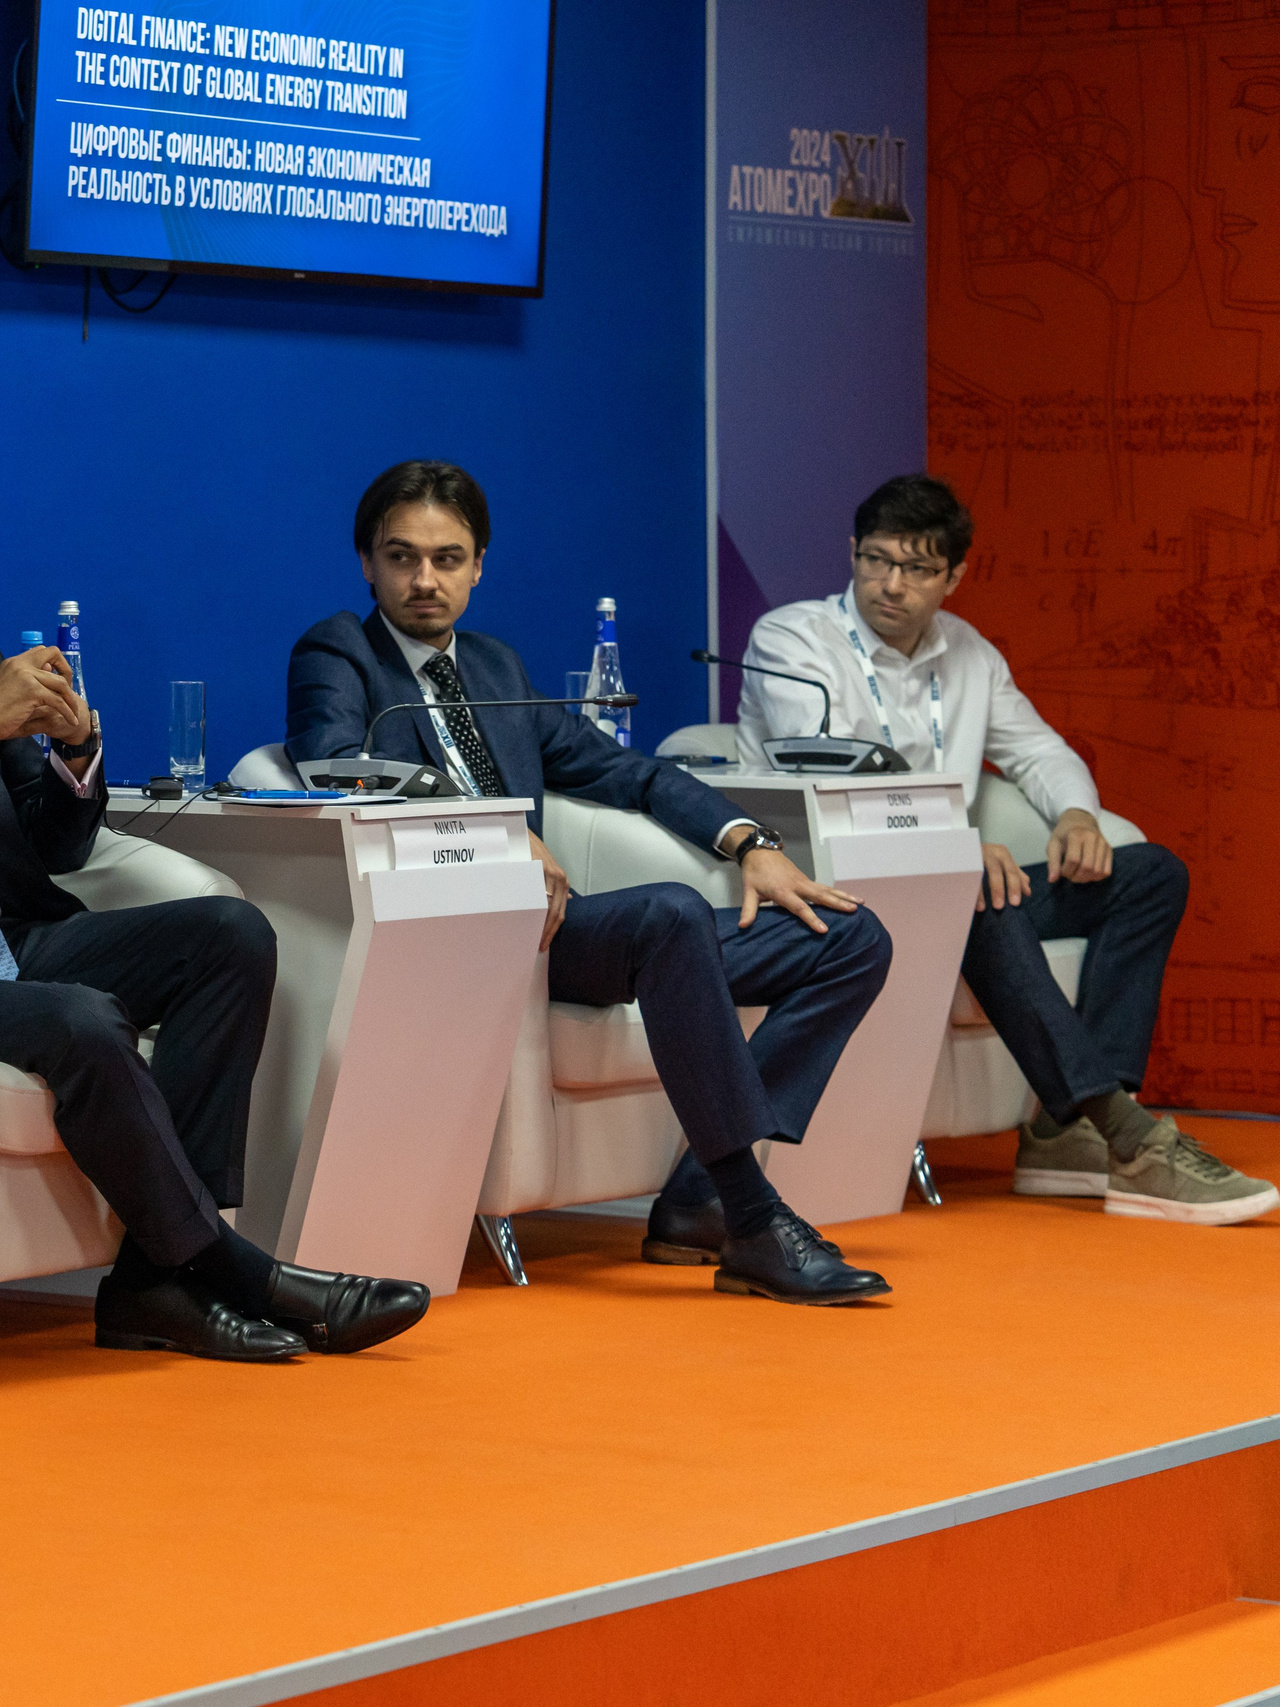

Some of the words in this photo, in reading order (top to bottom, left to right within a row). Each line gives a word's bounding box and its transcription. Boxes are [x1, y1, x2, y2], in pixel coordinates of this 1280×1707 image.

[76, 6, 137, 46] DIGITAL
[141, 15, 211, 55] FINANCE:
[214, 24, 249, 59] NEW
[251, 29, 326, 69] ECONOMIC
[328, 39, 387, 76] REALITY
[388, 47, 404, 79] IN
[75, 50, 107, 86] THE
[109, 54, 181, 94] CONTEXT
[183, 63, 204, 96] OF
[205, 66, 262, 103] GLOBAL
[265, 73, 324, 110] ENERGY
[325, 80, 408, 120] TRANSITION
[69, 121, 164, 162] ЦИФРОВЫЕ
[166, 132, 252, 171] ФИНАНСЫ:
[254, 140, 305, 176] НОВАЯ
[307, 146, 432, 188] ЭКОНОМИЧЕСКАЯ
[789, 128, 831, 168] 2024
[67, 165, 171, 206] РЕАЛЬНОСТЬ
[174, 174, 186, 207] В
[189, 176, 275, 215] УСЛОВИЯХ
[276, 184, 382, 224] ГЛОБАЛЬНОГО
[383, 194, 508, 238] ЭНЕРГОПЕРЕХОДА
[728, 164, 832, 219] ATOMEXPO
[434, 820, 467, 835] NIKITA
[887, 815, 918, 828] DODON
[433, 848, 474, 864] USTINOV
